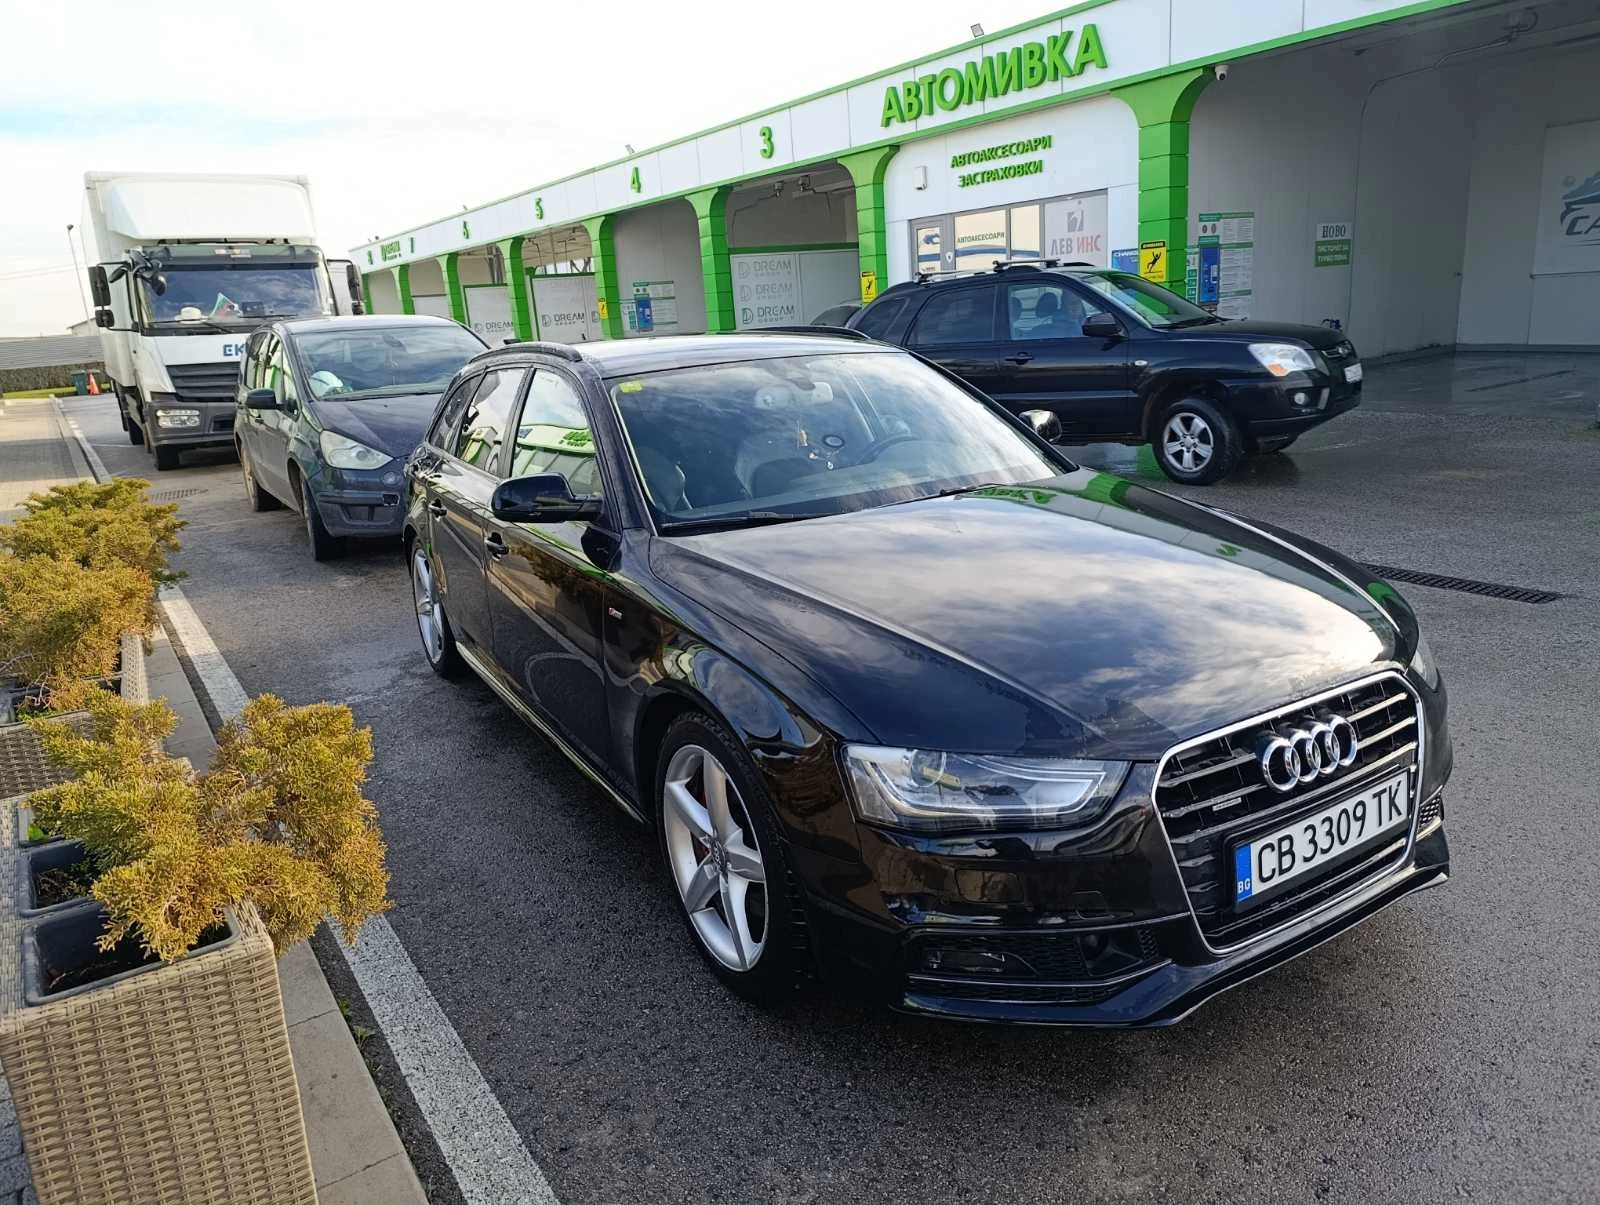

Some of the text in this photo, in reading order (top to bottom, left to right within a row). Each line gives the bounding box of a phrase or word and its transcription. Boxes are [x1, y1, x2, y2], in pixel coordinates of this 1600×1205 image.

[880, 24, 1108, 127] АВТОМИВКА
[759, 126, 774, 159] 3
[951, 135, 1052, 168] АВТОАКСЕСОАРИ
[630, 166, 642, 193] 4
[958, 159, 1044, 188] ЗАСТРАХОВКИ
[535, 198, 544, 220] 5
[1322, 224, 1346, 238] НОВО
[1050, 234, 1101, 256] ЛЕВ ИНС
[753, 260, 792, 272] DREAM
[755, 281, 793, 295] DREAM
[554, 312, 585, 322] DREAM
[757, 305, 795, 318] DREAM
[1257, 780, 1403, 883] CB 3309 TK
[1237, 879, 1251, 894] BG
